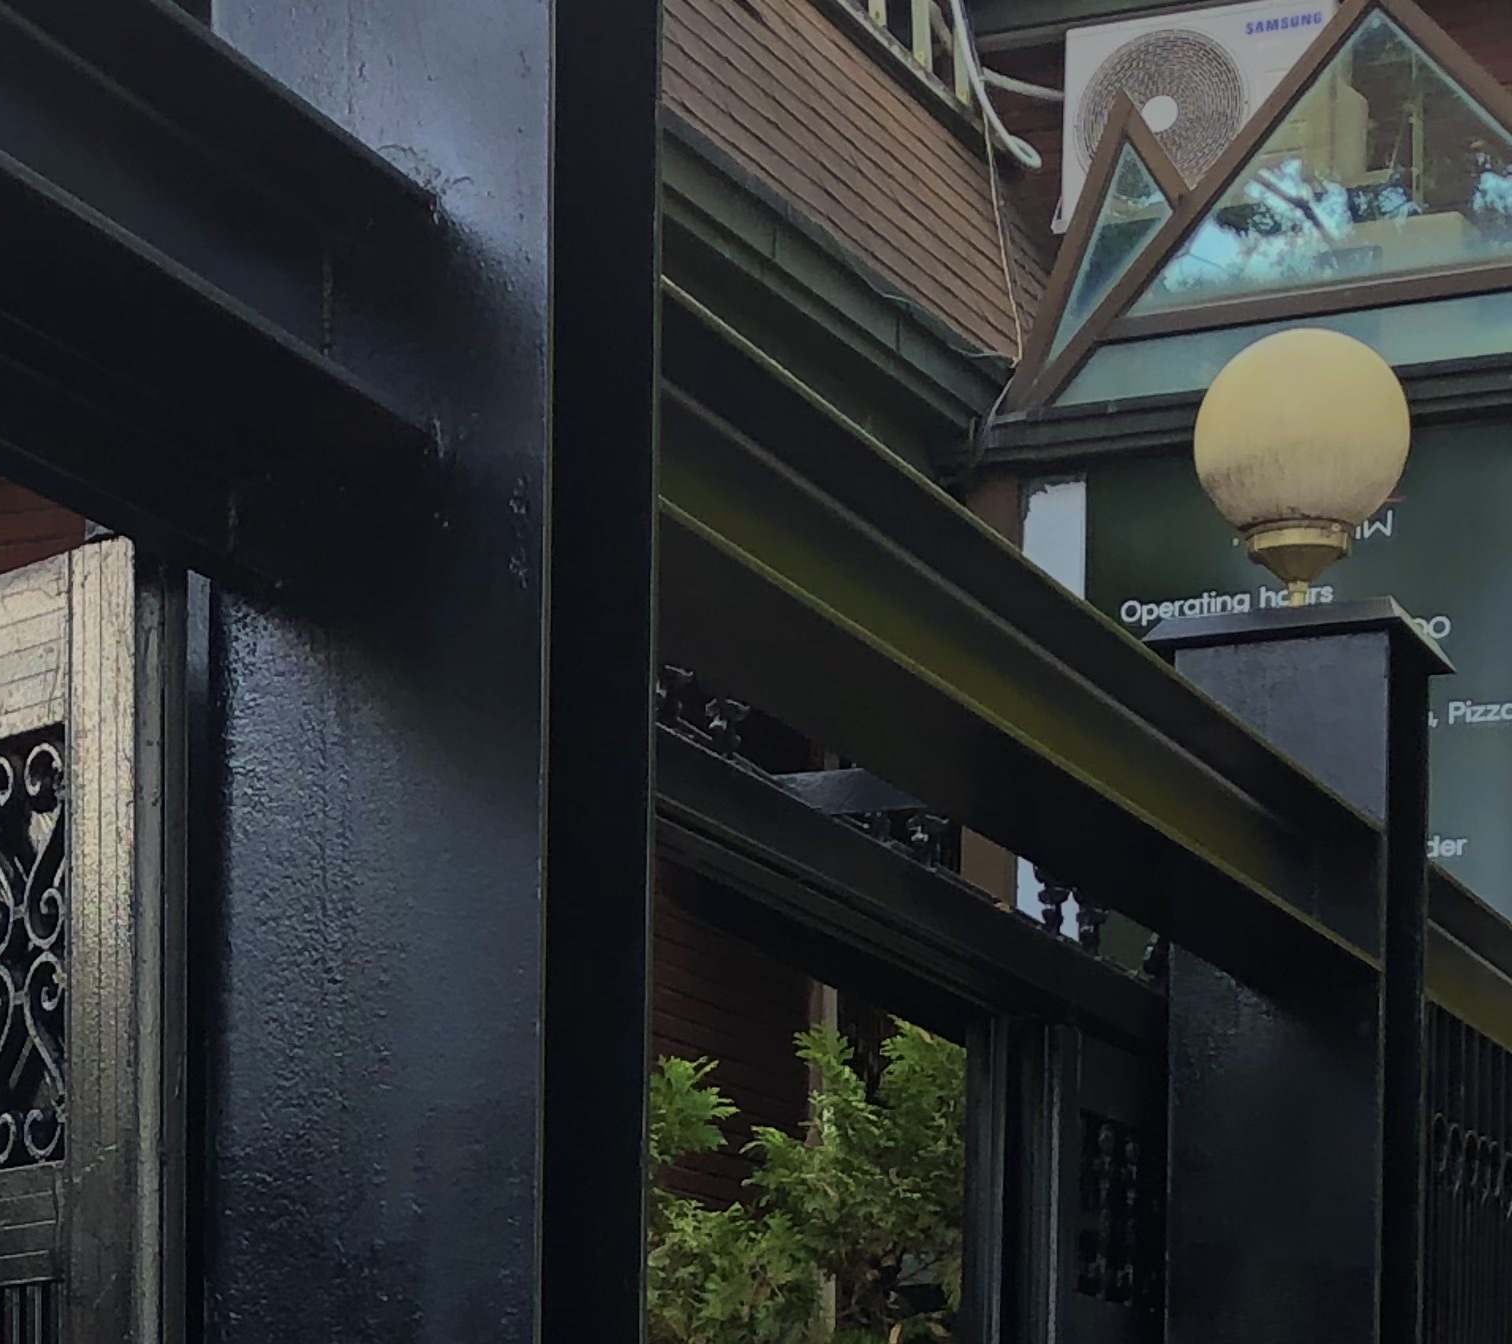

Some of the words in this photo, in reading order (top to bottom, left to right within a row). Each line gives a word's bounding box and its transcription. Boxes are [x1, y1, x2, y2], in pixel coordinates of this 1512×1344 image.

[1245, 11, 1323, 36] SAMSUNG
[1120, 591, 1251, 626] Operating
[1259, 585, 1335, 609] hors
